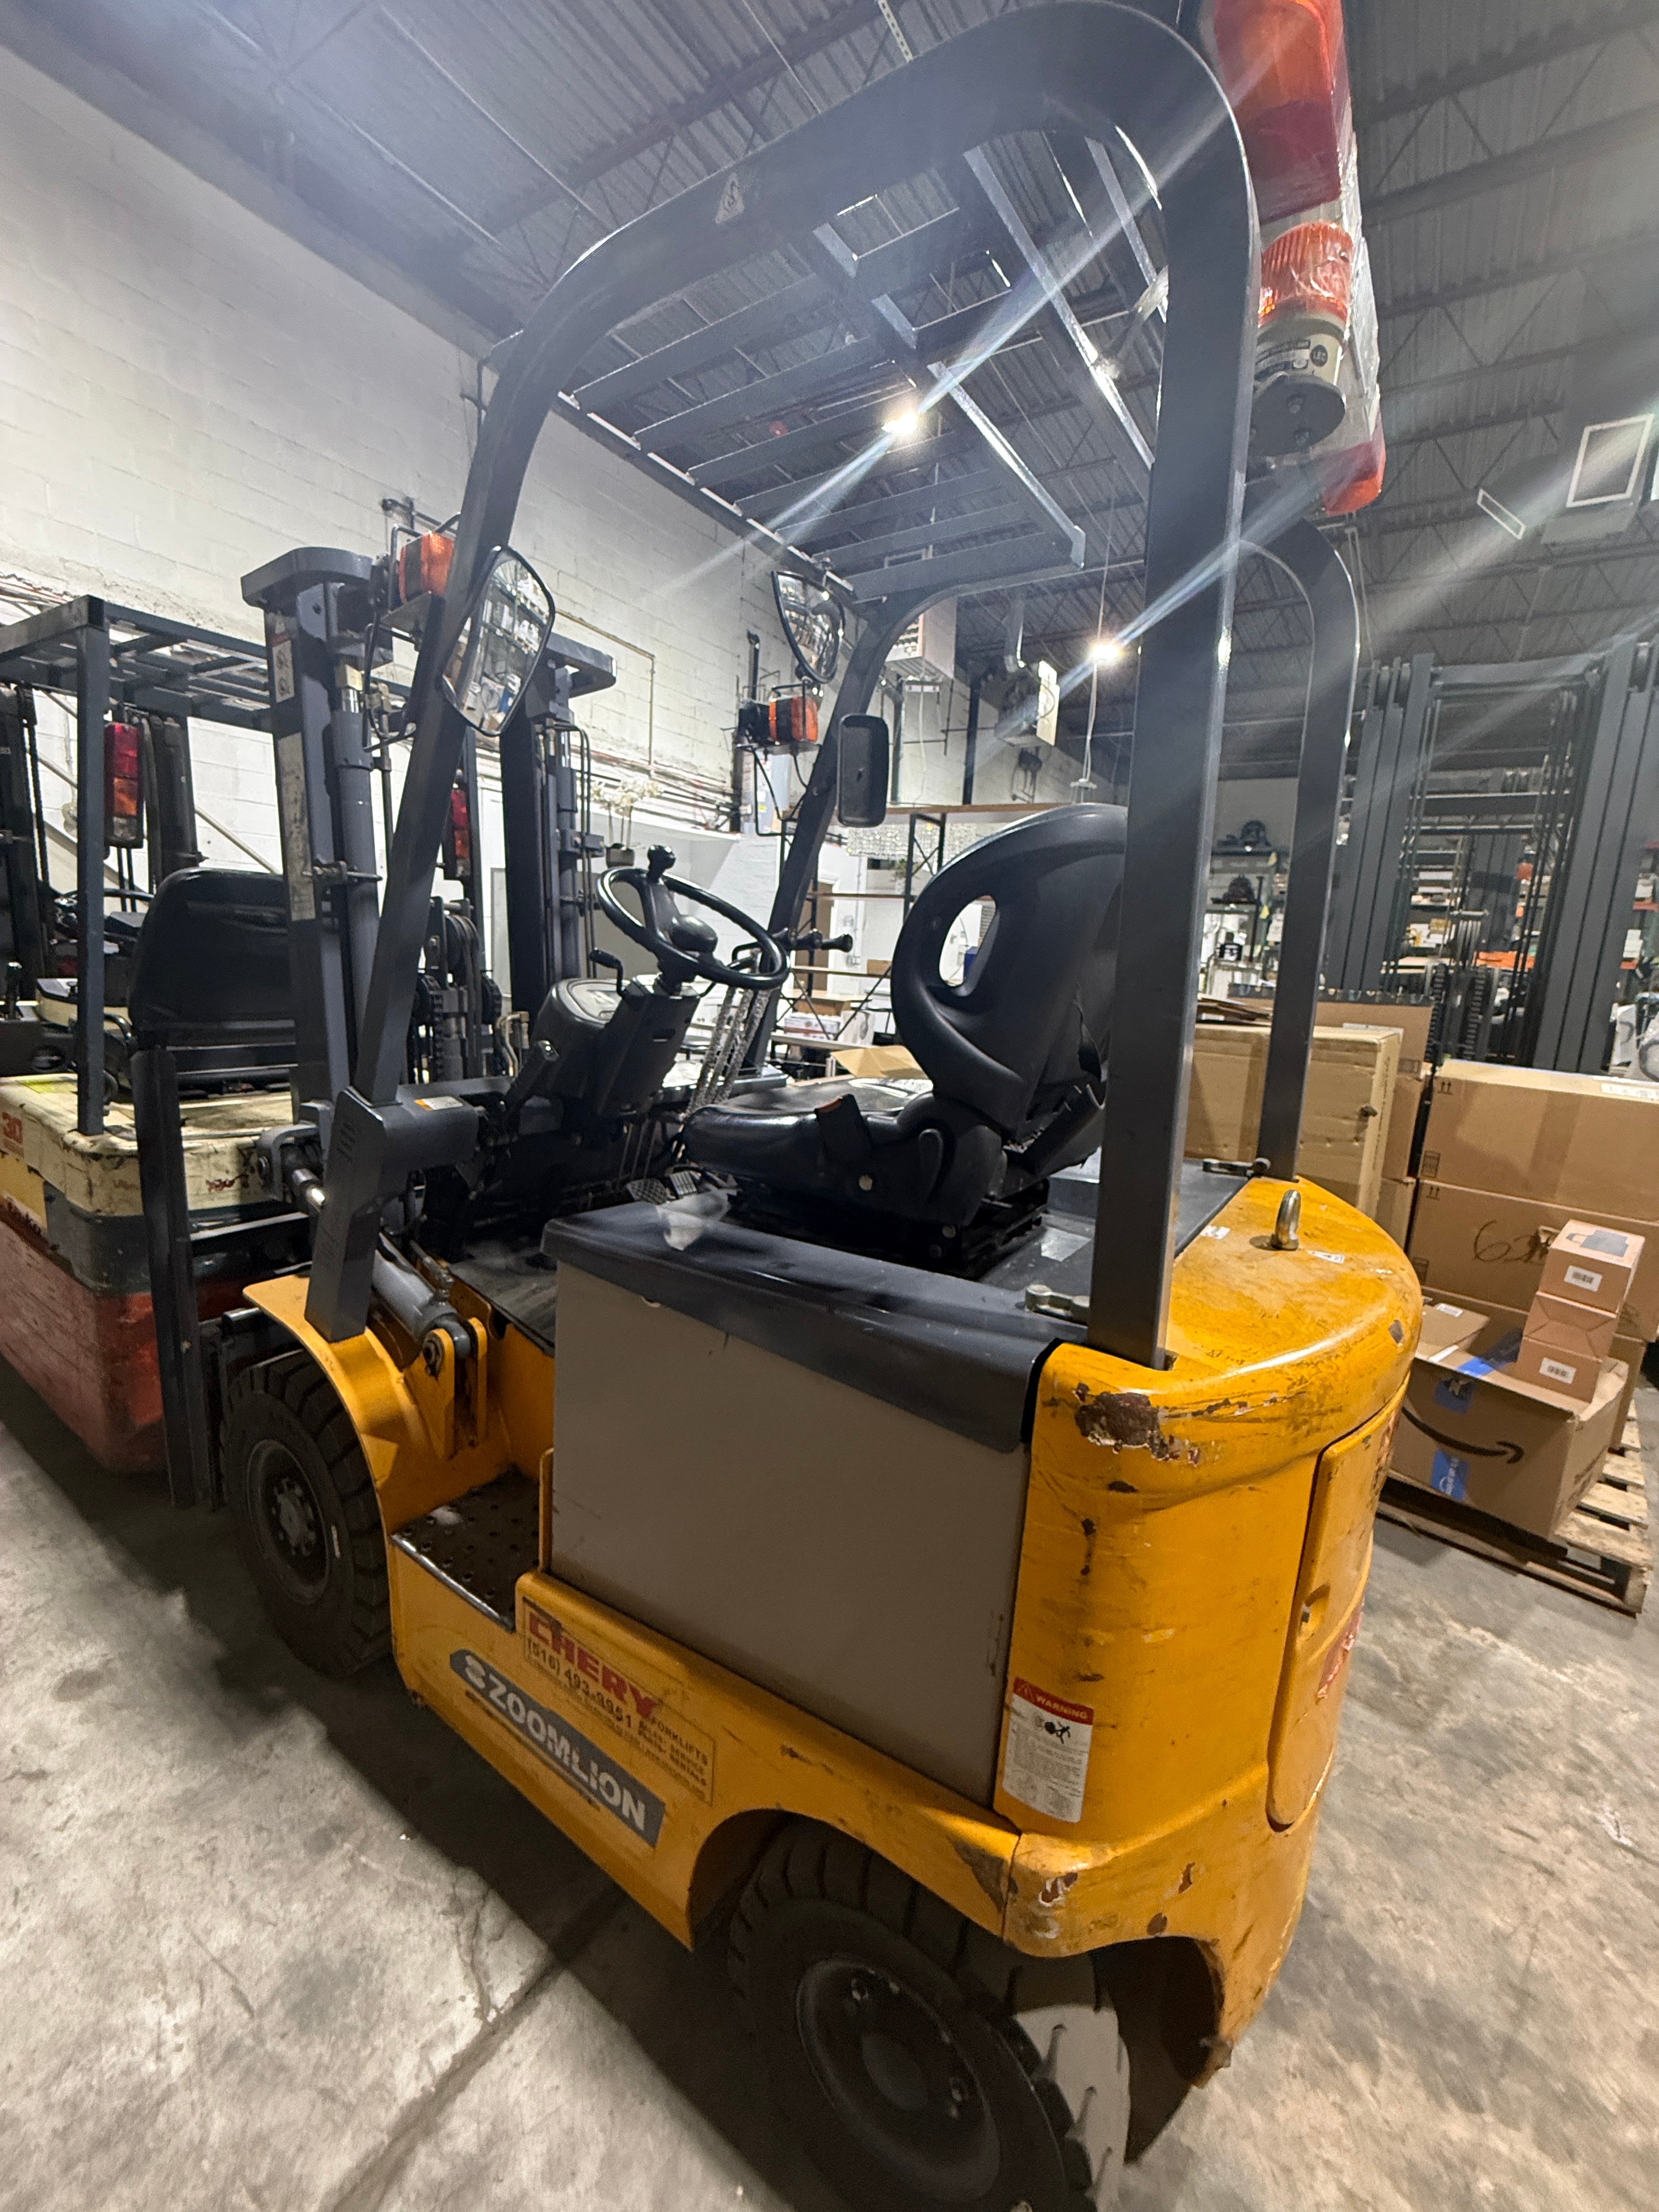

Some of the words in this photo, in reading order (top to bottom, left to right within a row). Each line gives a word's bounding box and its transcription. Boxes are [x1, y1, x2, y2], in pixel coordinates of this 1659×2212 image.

[529, 1611, 658, 1719] CHERY
[1036, 1694, 1088, 1720] WARNING
[488, 1673, 646, 1831] ZOOMLION
